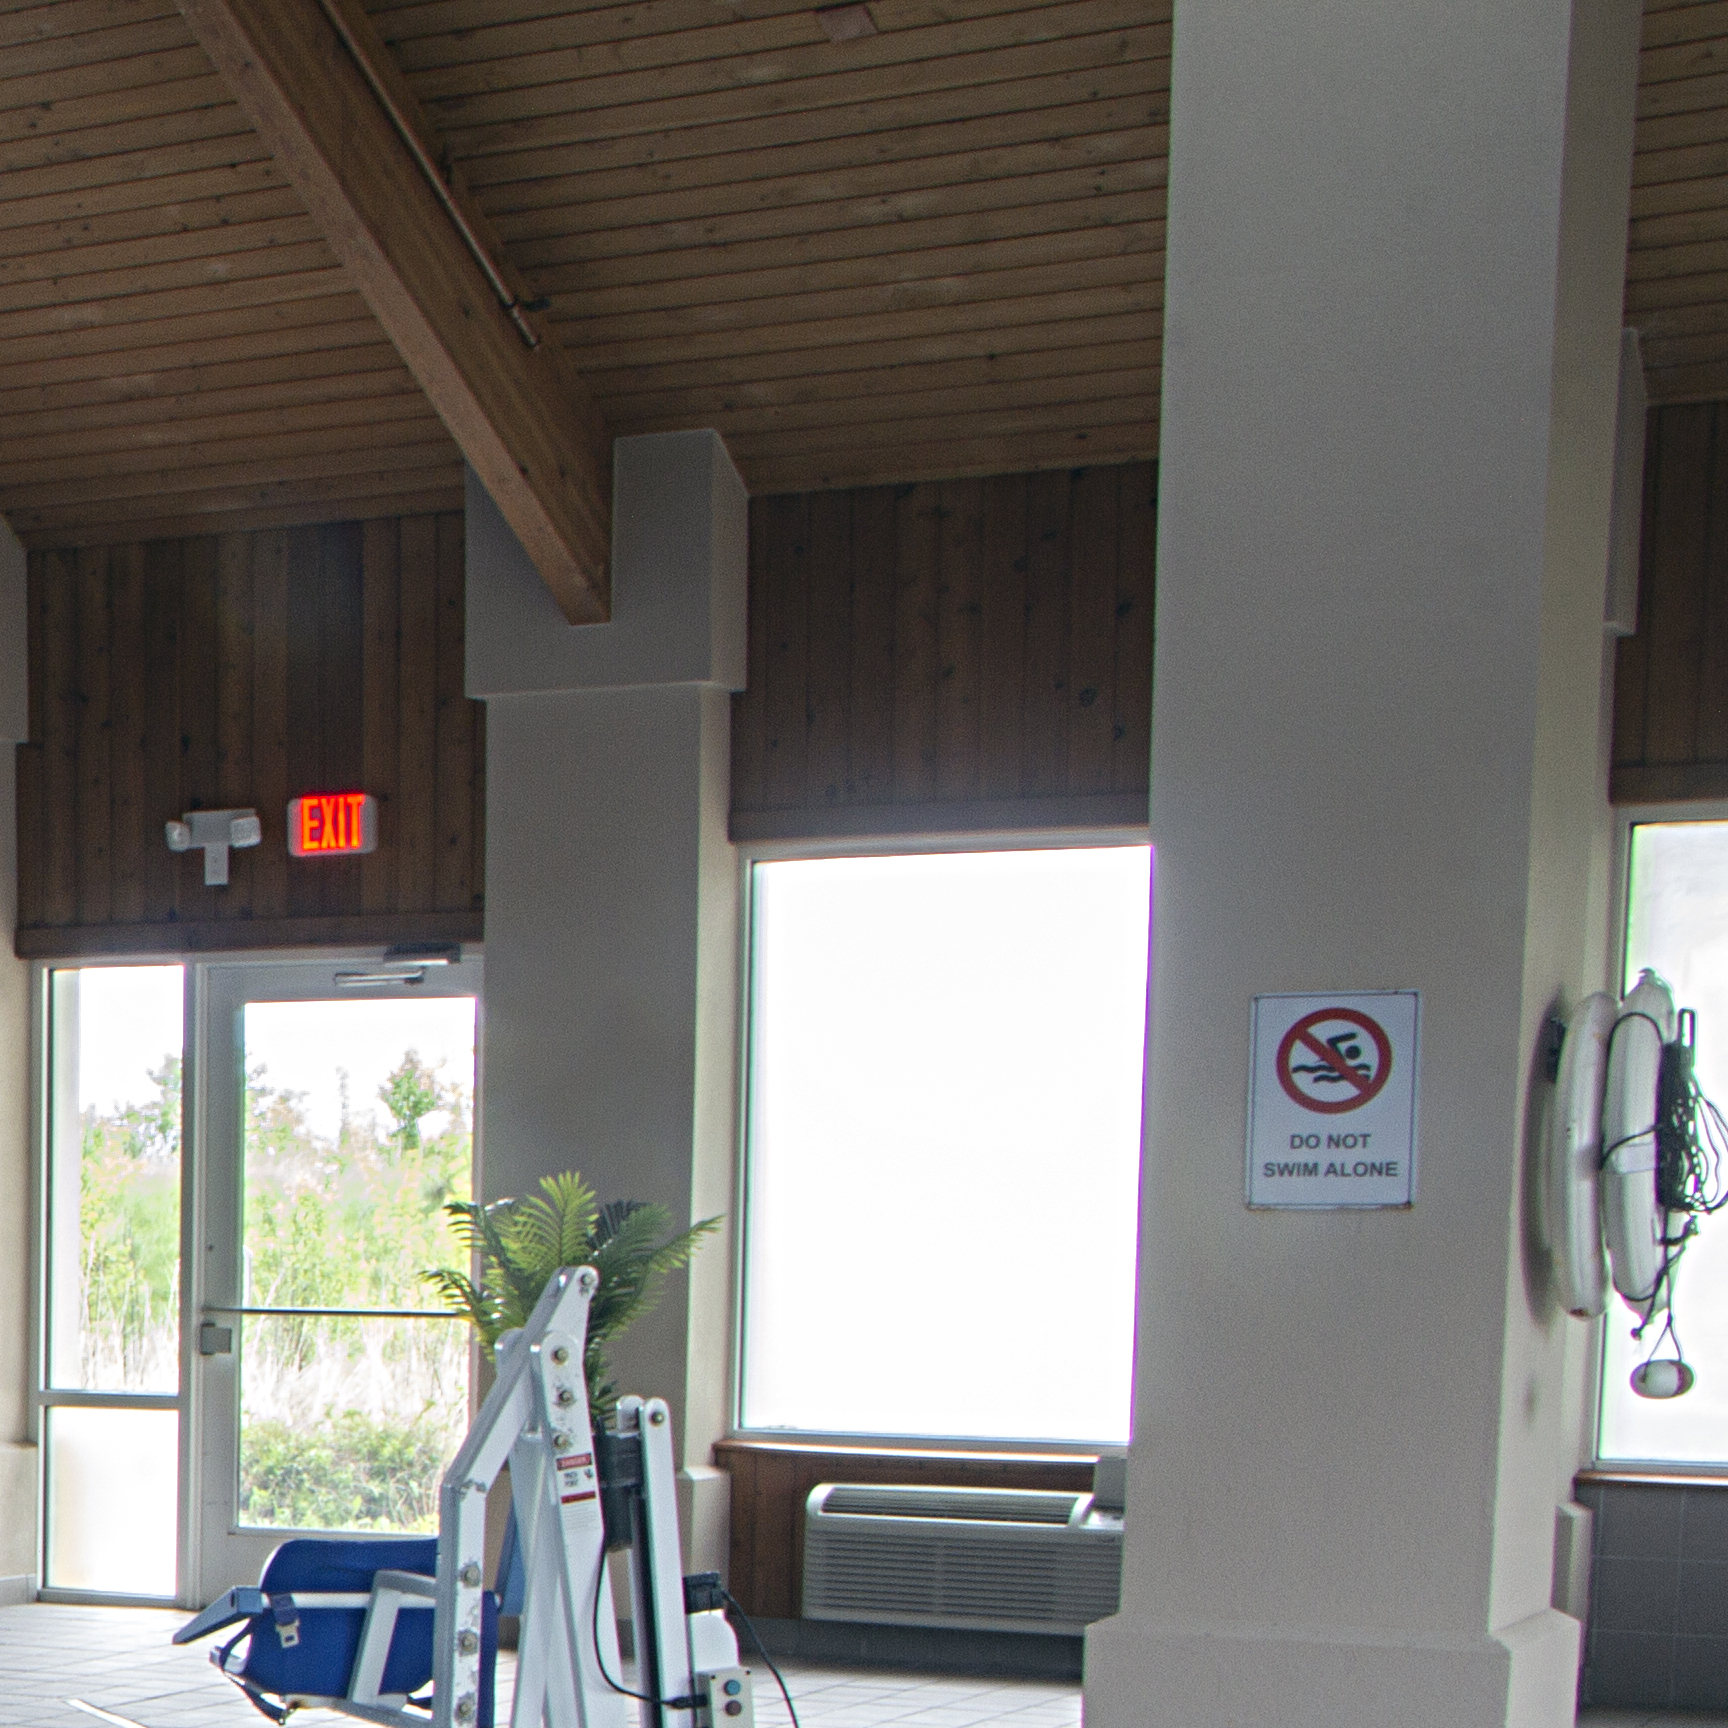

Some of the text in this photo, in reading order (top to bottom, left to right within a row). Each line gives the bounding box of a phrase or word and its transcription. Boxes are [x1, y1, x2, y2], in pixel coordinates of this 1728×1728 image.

[301, 794, 365, 851] EXIT
[1289, 1133, 1371, 1149] DO NOT
[1263, 1161, 1398, 1177] SWIM ALONE
